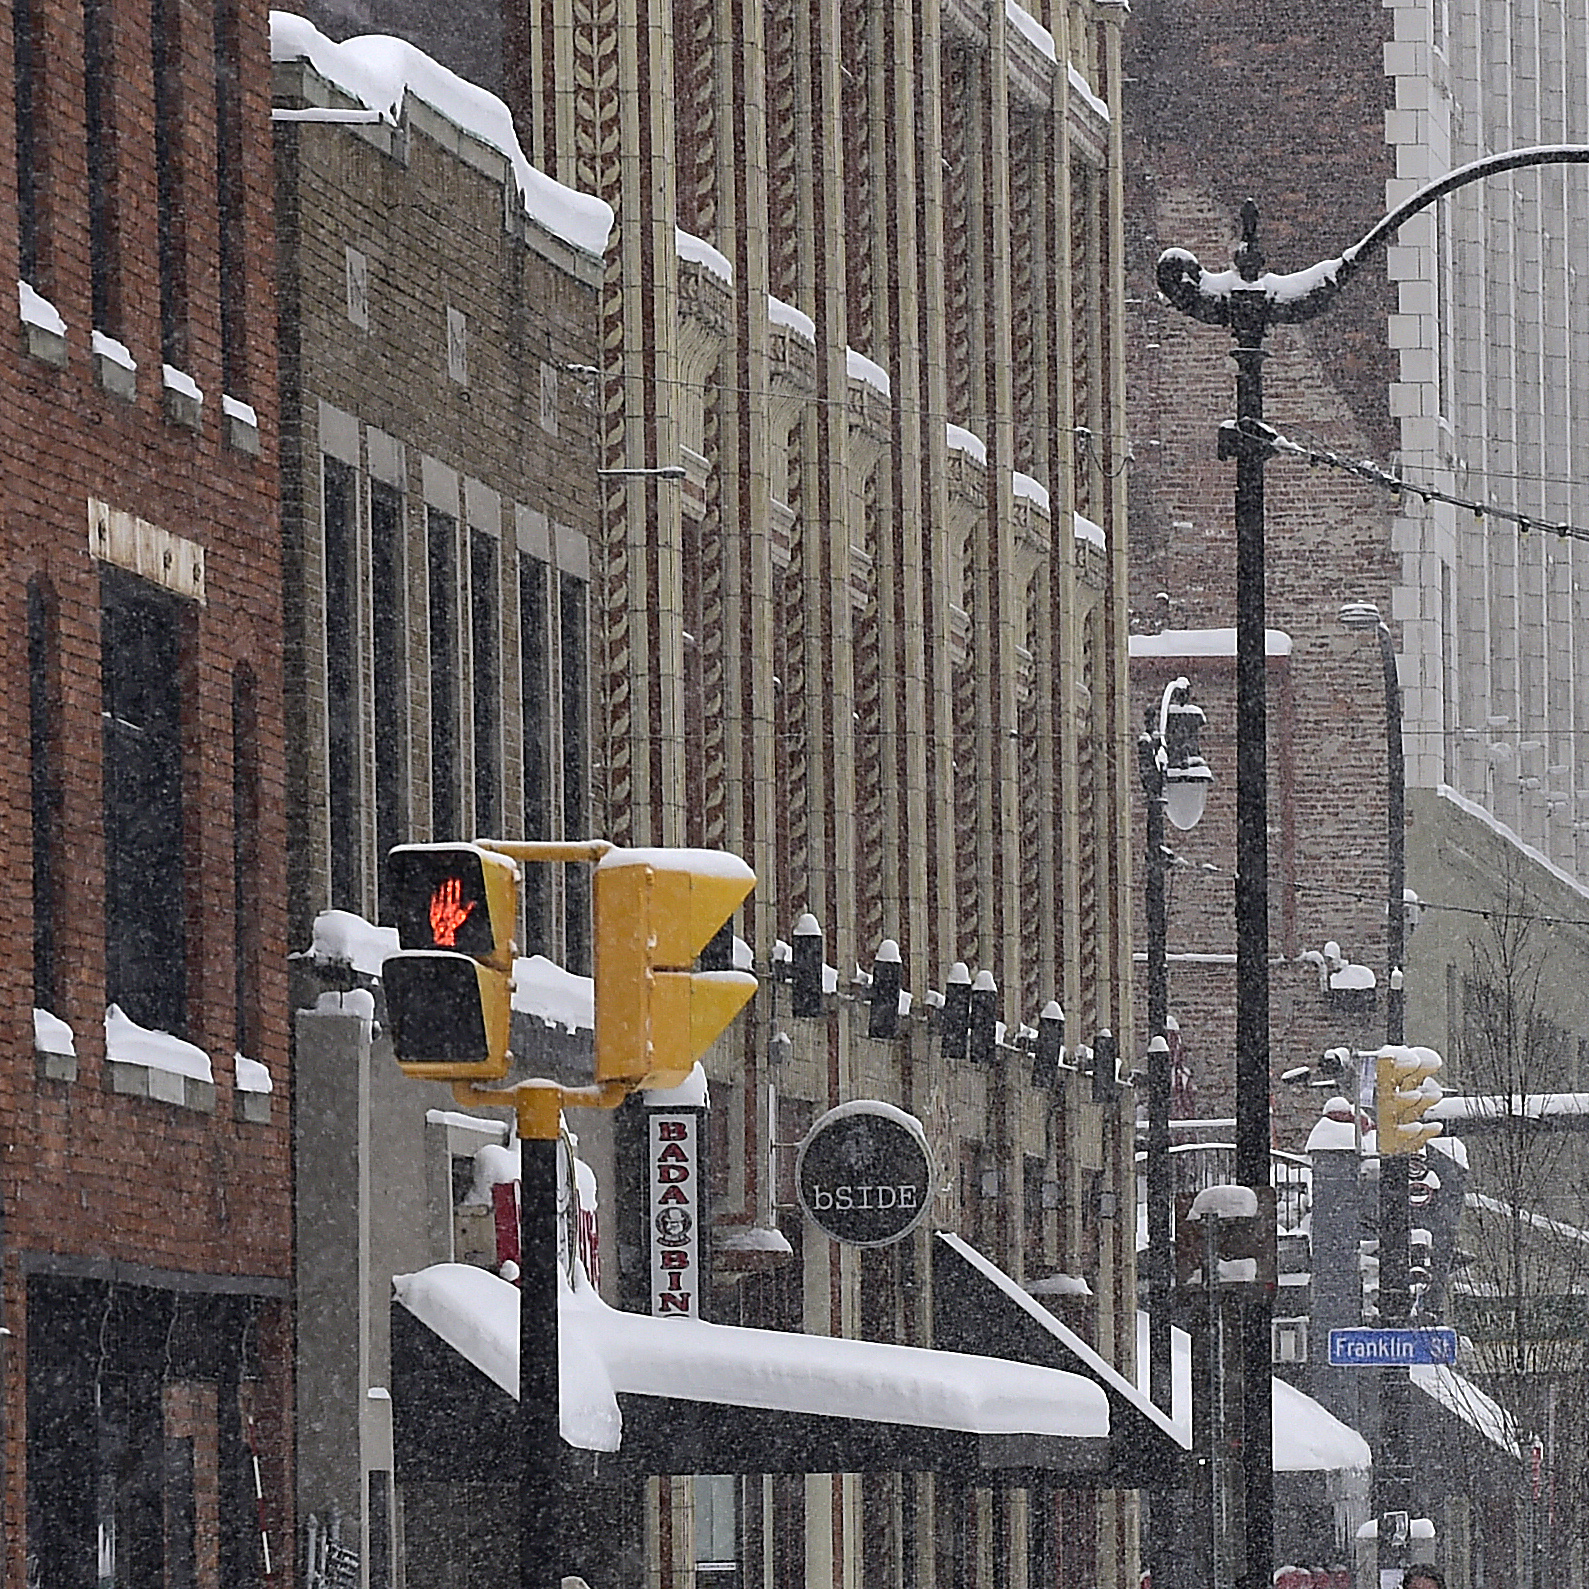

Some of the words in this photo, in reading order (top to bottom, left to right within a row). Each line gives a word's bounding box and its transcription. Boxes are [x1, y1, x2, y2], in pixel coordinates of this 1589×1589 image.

[657, 1121, 690, 1205] BADA
[813, 1185, 917, 1210] bSIDE
[659, 1250, 692, 1318] BIN
[1336, 1337, 1414, 1357] Franklin
